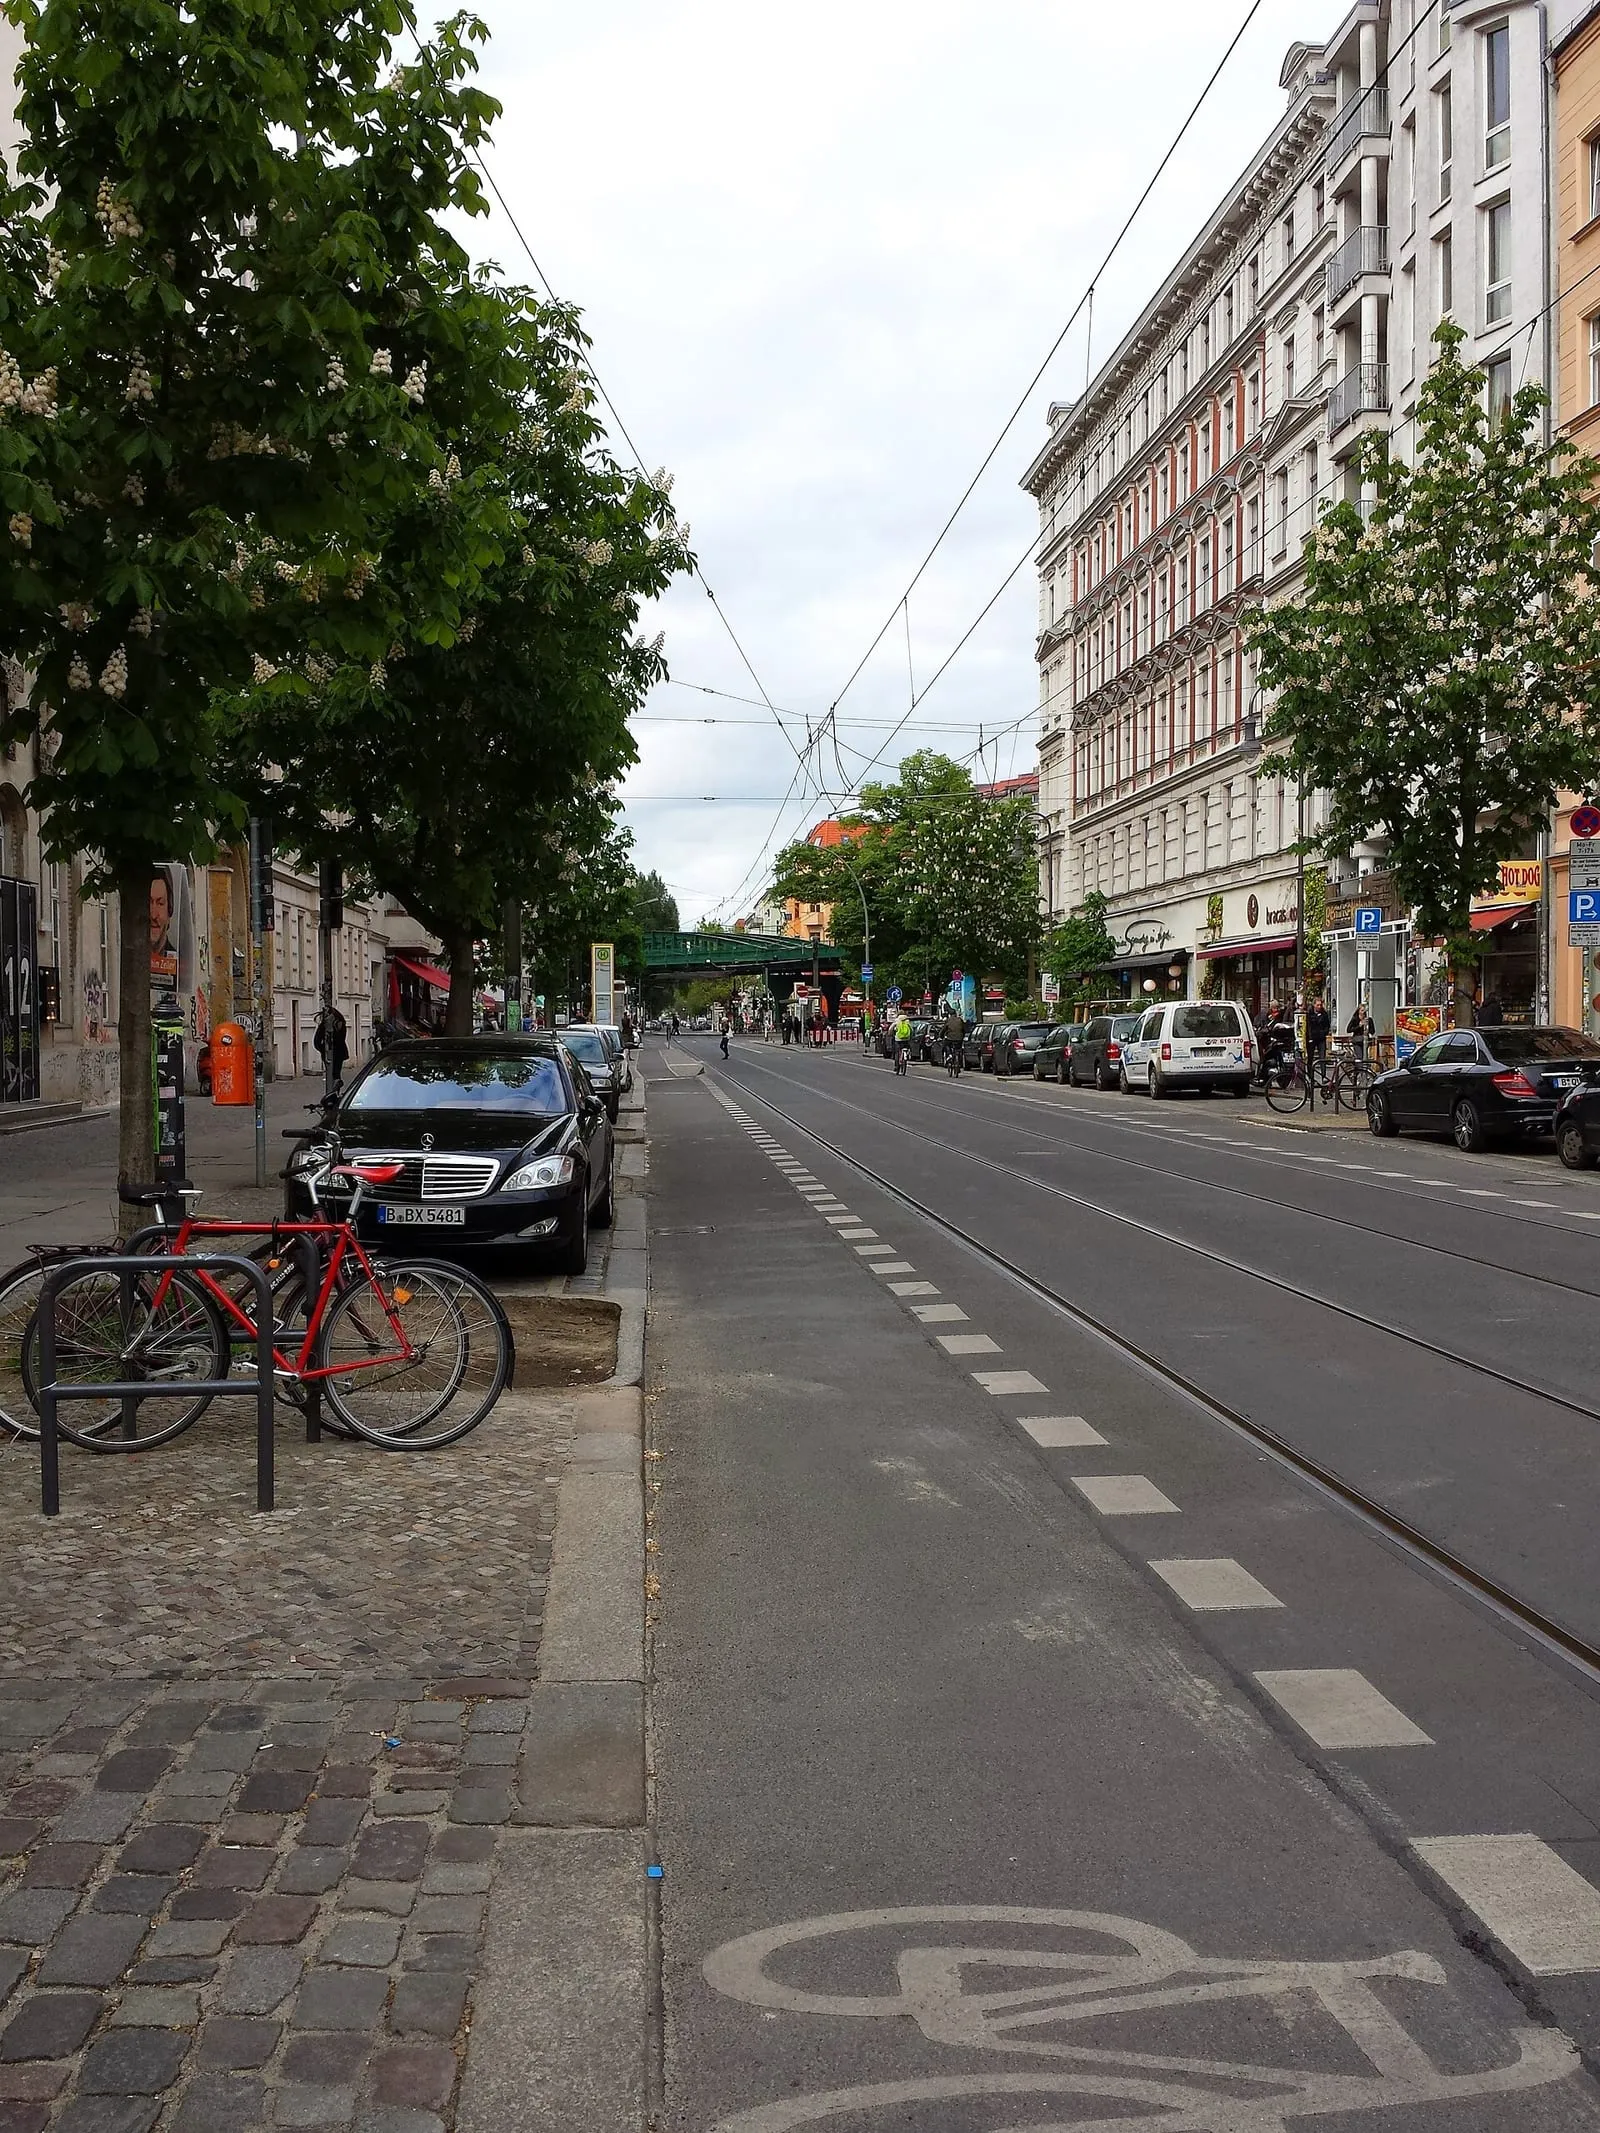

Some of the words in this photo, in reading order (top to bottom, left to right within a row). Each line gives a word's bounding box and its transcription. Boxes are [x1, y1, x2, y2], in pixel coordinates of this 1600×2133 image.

[1501, 865, 1520, 887] HOT
[1522, 865, 1540, 887] DOG
[1576, 895, 1595, 919] P
[1361, 911, 1375, 930] P
[5, 956, 31, 1016] 12
[387, 1207, 396, 1222] B
[405, 1208, 424, 1223] BX
[426, 1208, 463, 1223] 5481
